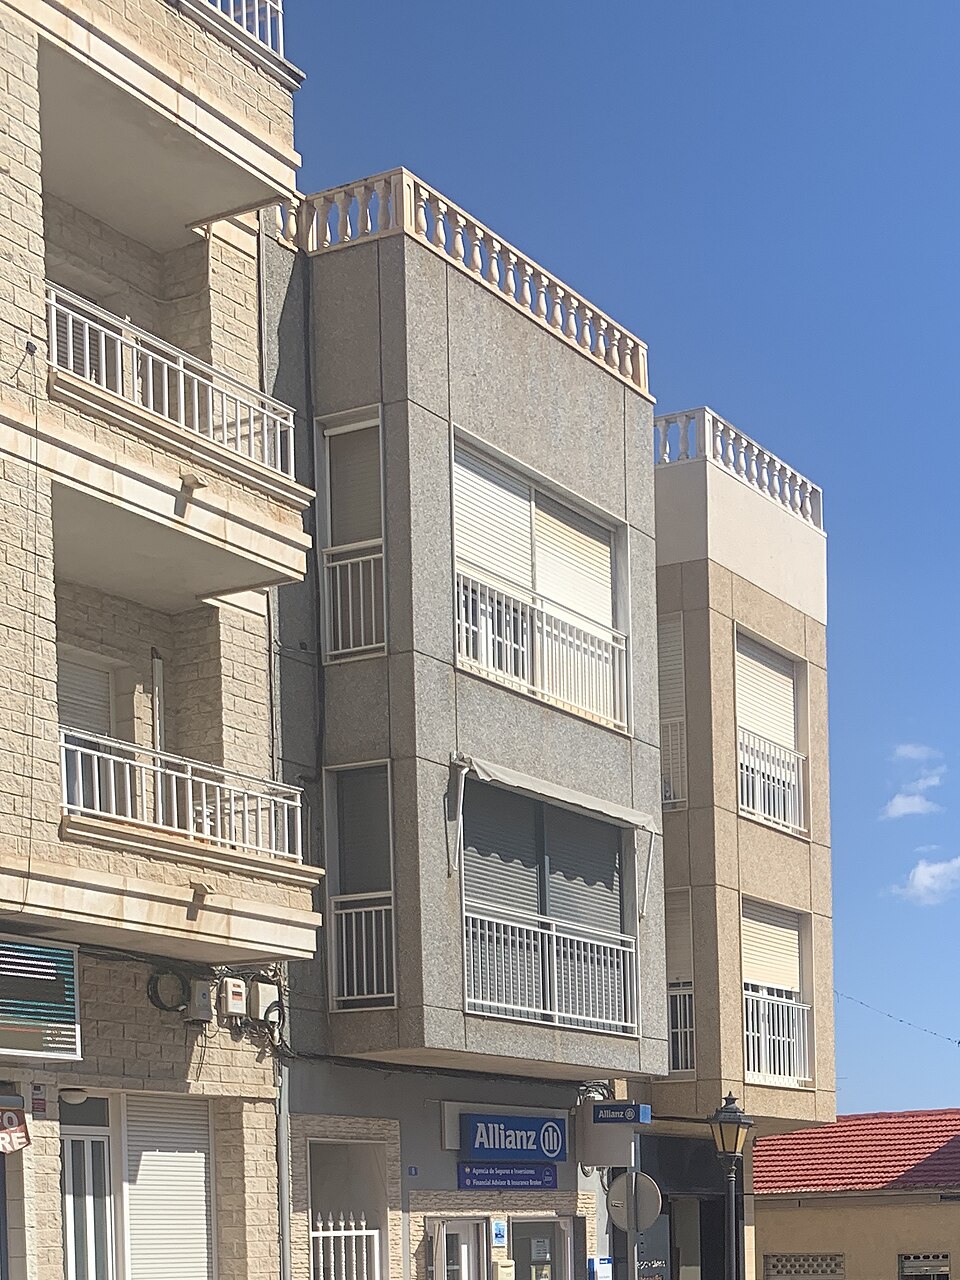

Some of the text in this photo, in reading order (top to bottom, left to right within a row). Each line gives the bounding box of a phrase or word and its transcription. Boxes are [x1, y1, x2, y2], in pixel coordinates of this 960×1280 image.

[0, 1111, 19, 1129] O
[598, 1109, 625, 1119] Allianz
[474, 1121, 537, 1150] Allianz
